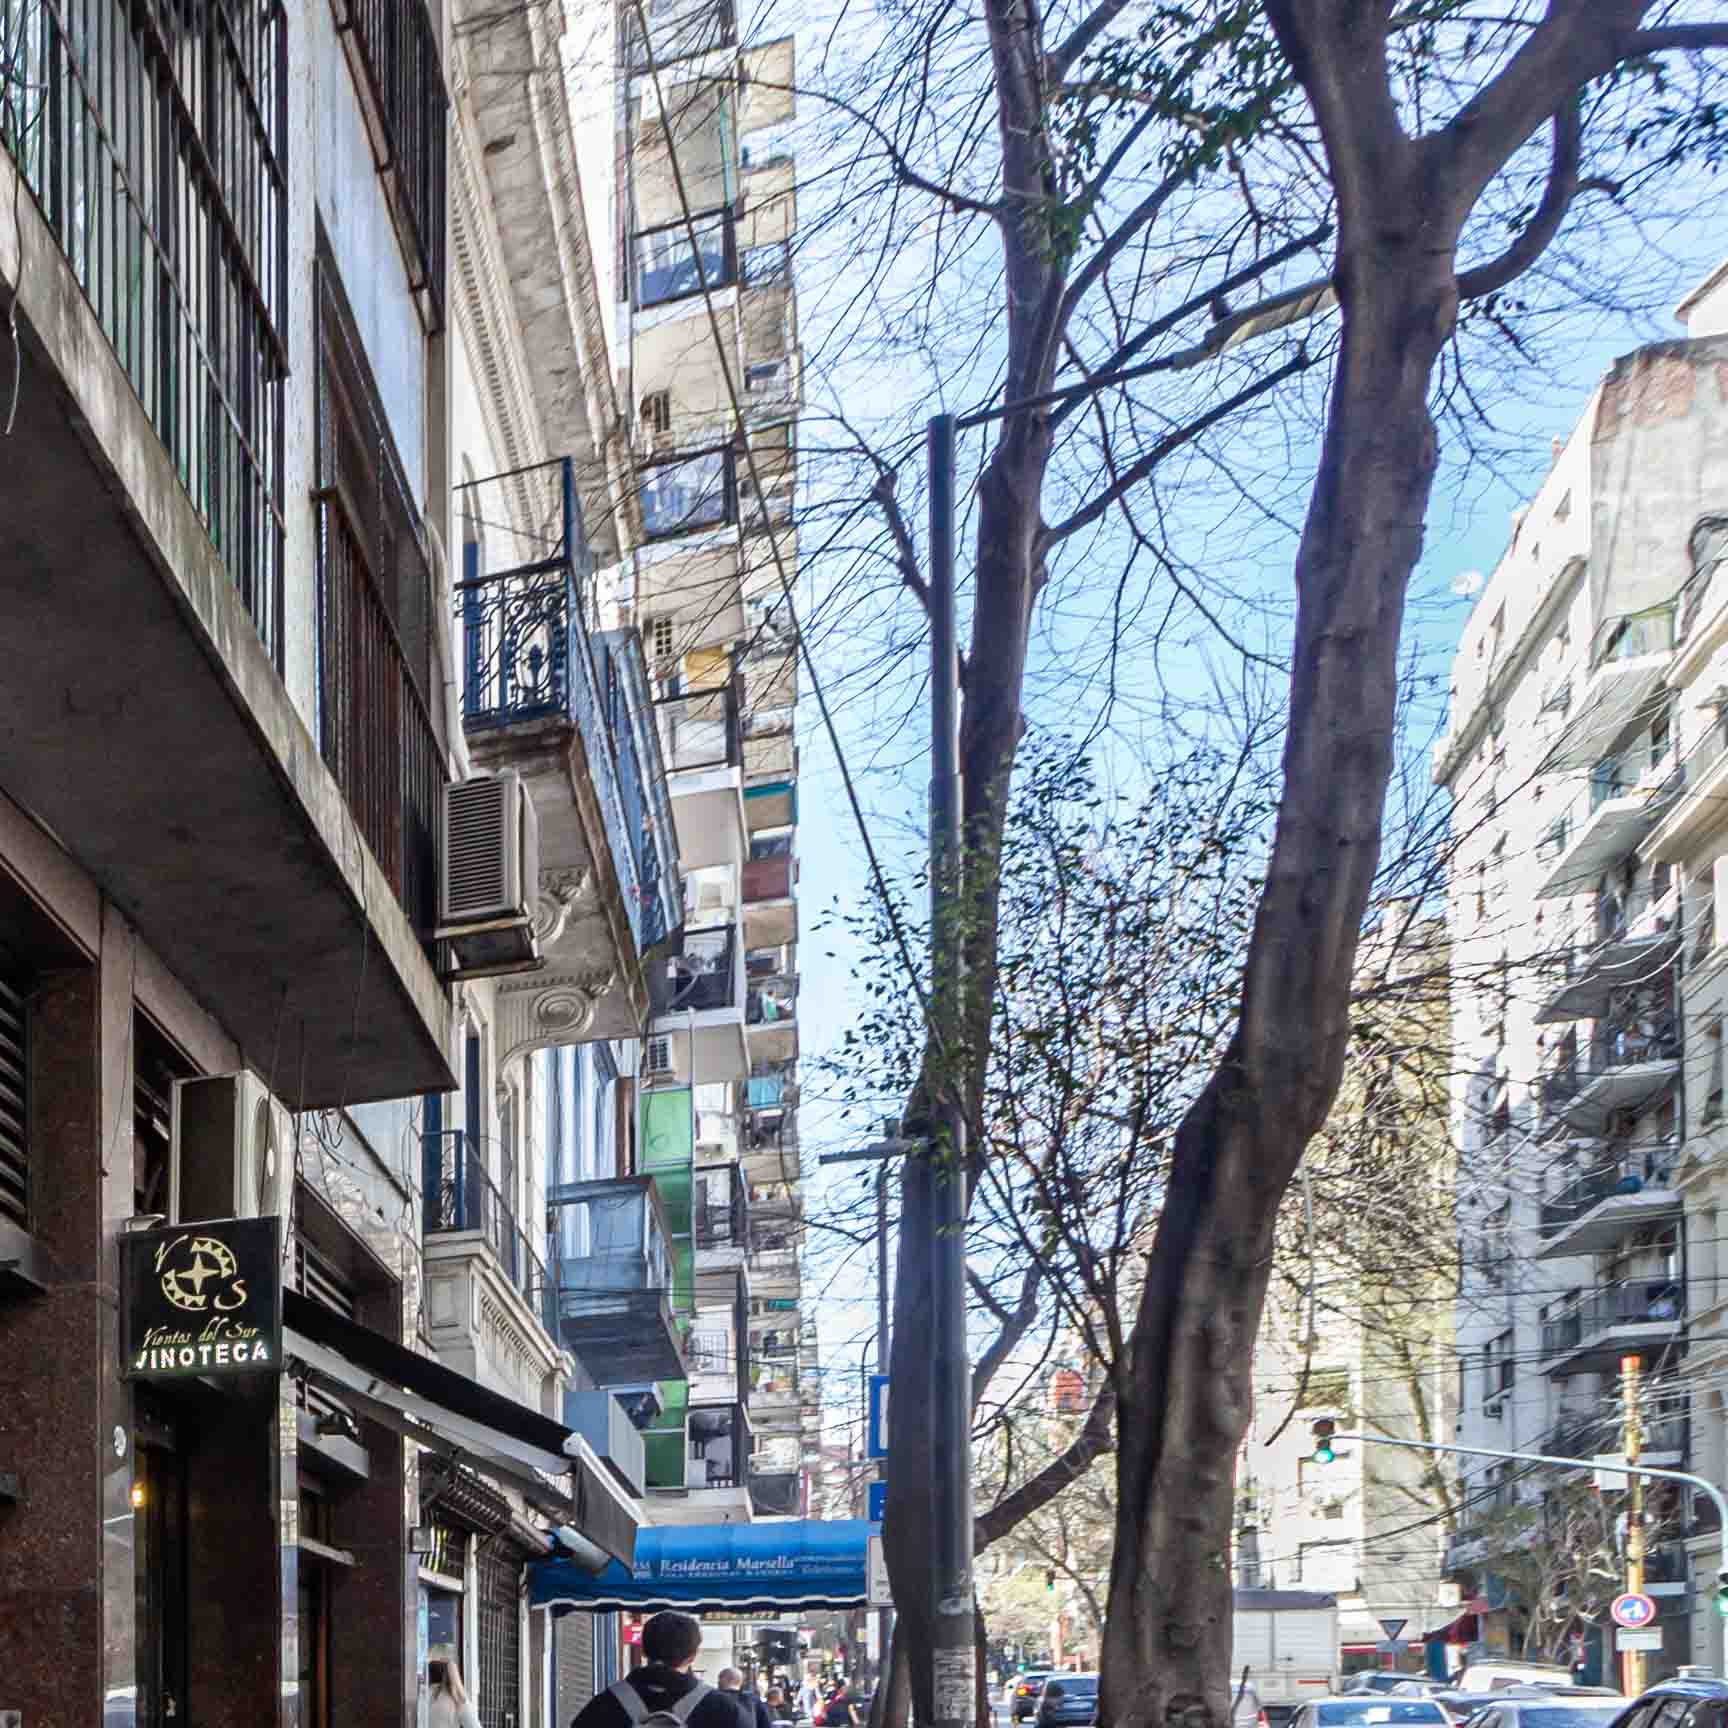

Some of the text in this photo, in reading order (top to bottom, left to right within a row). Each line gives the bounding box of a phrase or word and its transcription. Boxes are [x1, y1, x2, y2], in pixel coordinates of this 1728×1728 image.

[143, 1316, 261, 1349] Vientos del Sur
[736, 1555, 795, 1570] Marsella
